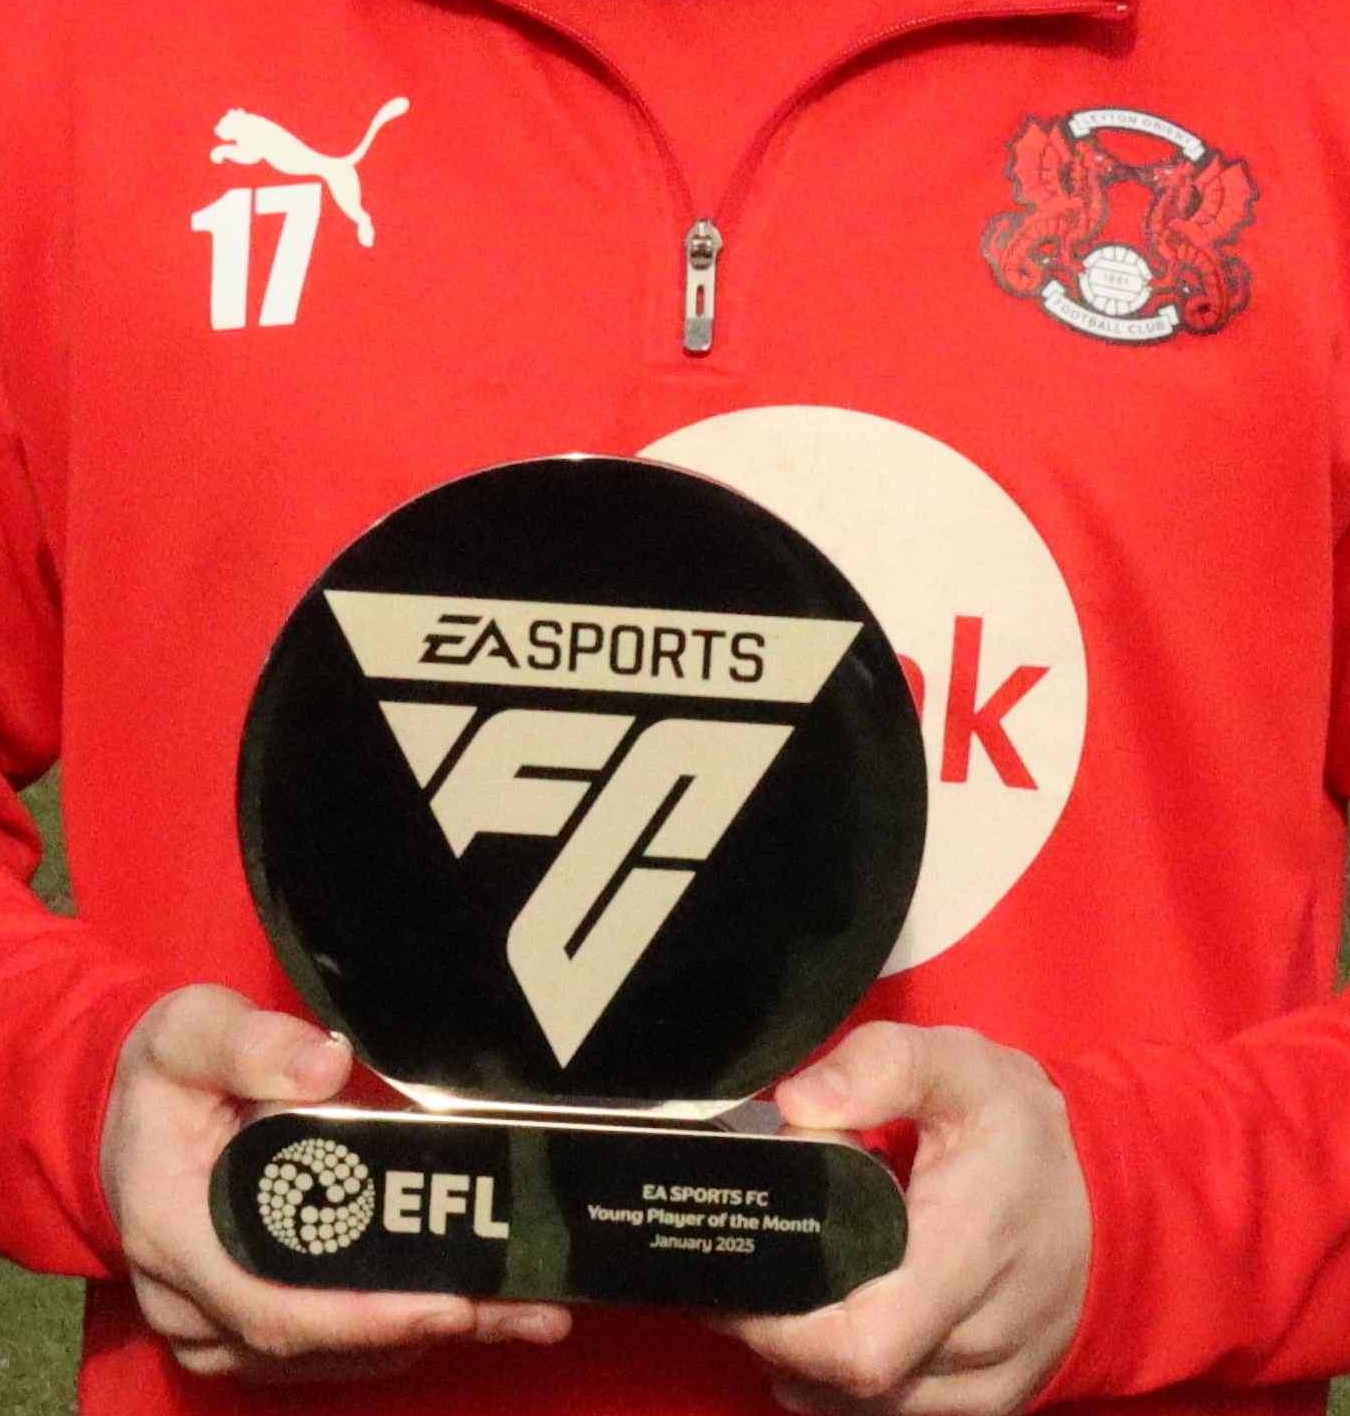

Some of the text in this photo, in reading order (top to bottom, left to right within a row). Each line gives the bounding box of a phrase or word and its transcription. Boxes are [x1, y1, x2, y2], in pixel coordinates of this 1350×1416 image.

[1082, 113, 1194, 145] LEYTON ORIENT
[190, 182, 323, 331] 17
[1052, 296, 1166, 335] FOOTBALL CLUB
[418, 614, 766, 683] EA SPORTS
[895, 614, 1051, 791] k
[383, 1170, 509, 1240] EFL
[642, 1184, 770, 1207] EA SPORTS FC
[587, 1204, 821, 1233] Young Player of the Month
[649, 1233, 756, 1254] January 2025
